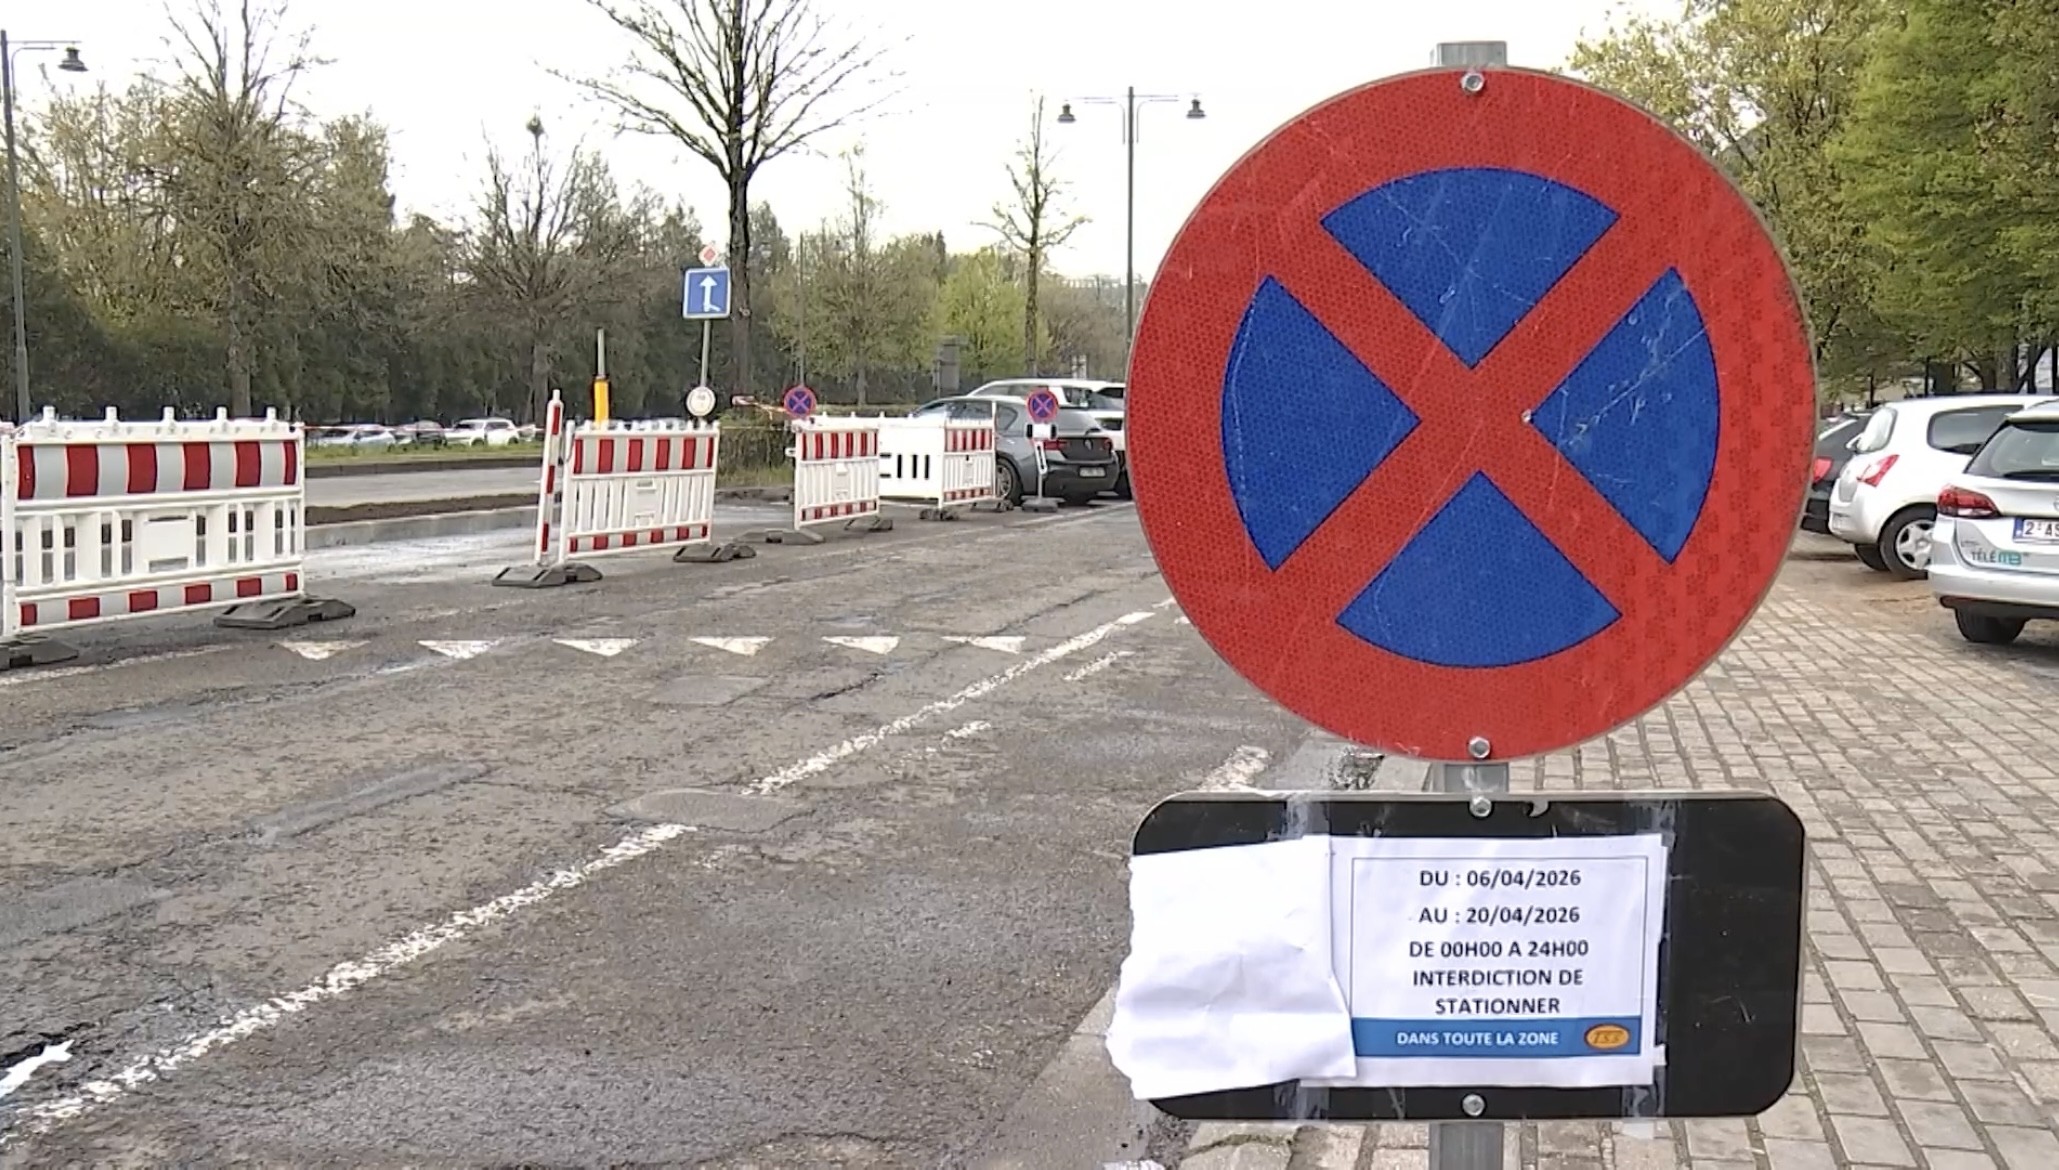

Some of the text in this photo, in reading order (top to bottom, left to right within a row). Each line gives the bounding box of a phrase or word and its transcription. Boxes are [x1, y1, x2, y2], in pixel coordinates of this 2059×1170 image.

[1420, 869, 1582, 890] DU : 06/04/2026
[1419, 906, 1581, 927] AU : 20/04/2026
[1409, 939, 1590, 958] DE 00H00 A 24H00
[1412, 969, 1584, 987] INTERDICTION DE
[1435, 998, 1561, 1015] STATIONNER
[1396, 1032, 1559, 1045] DANS TOUTE LA ZONE
